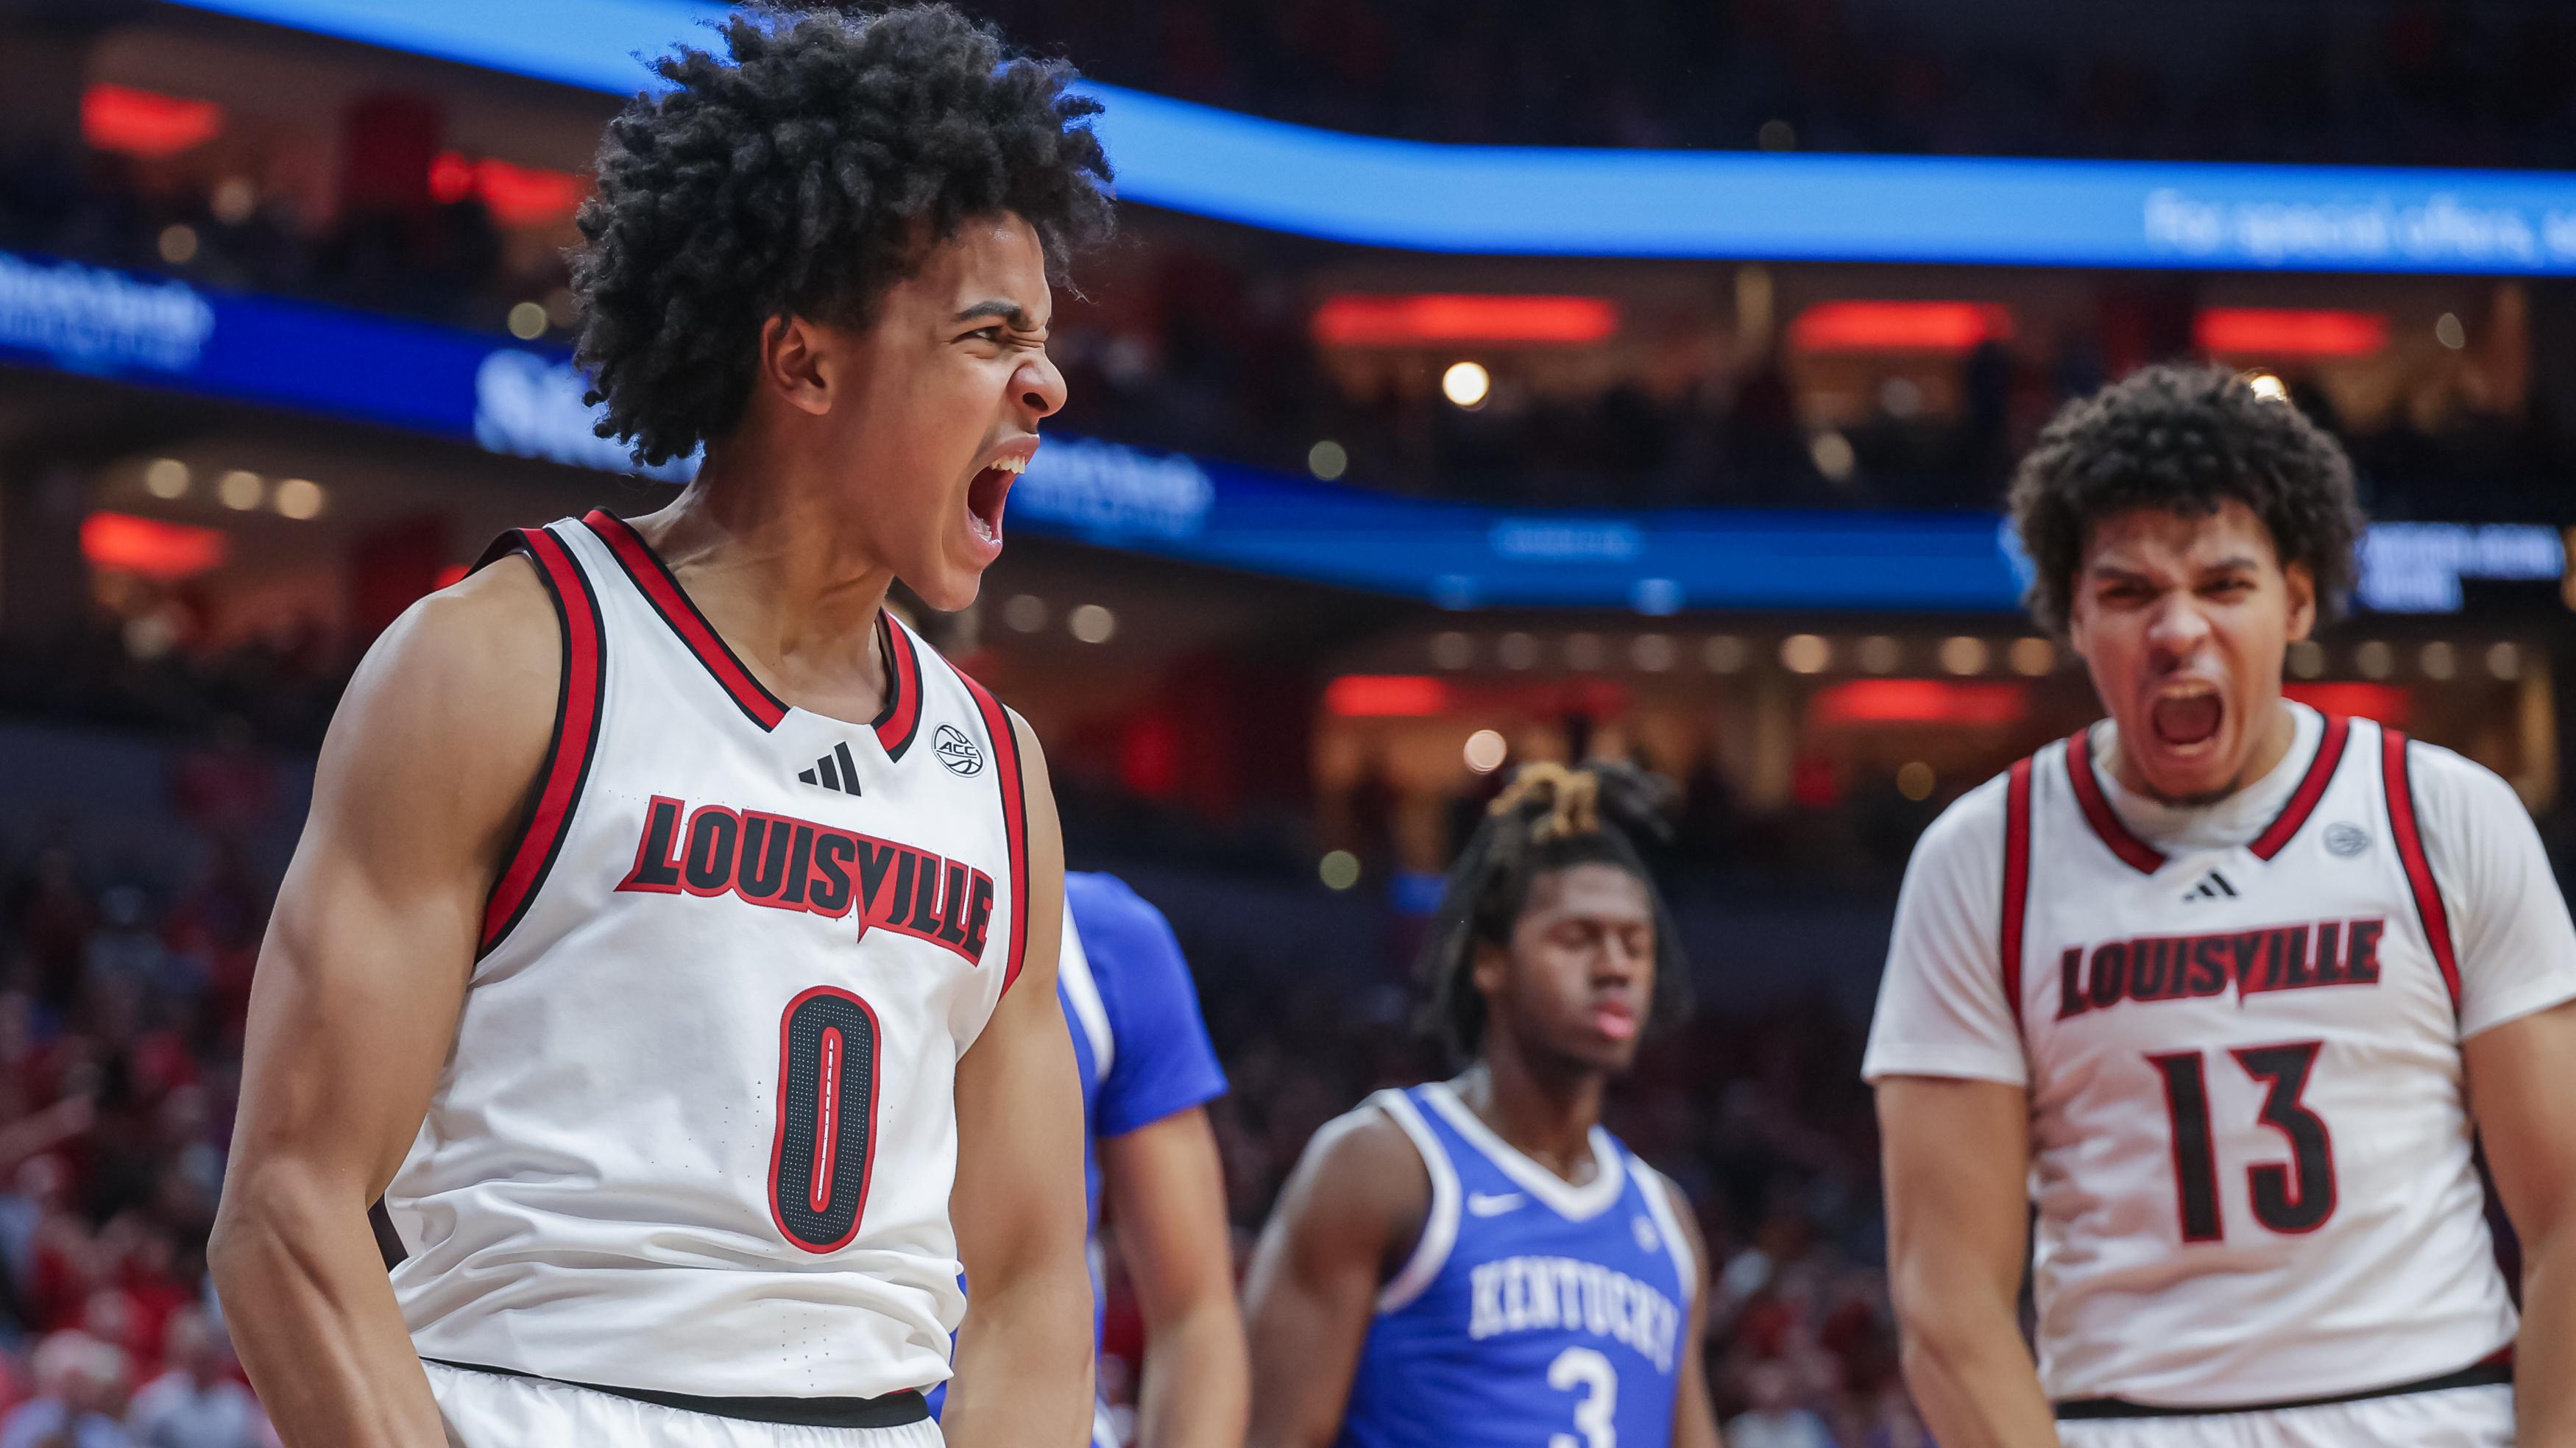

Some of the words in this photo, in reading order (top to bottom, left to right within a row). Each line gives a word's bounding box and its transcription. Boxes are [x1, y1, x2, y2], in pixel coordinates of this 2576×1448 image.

[938, 741, 976, 756] ACC
[613, 795, 994, 967] LOUISVILLE
[2055, 916, 2385, 1022] LOUISVILLE
[768, 985, 881, 1254] 0
[2142, 1040, 2338, 1242] 13
[1469, 1255, 1680, 1374] KENTUCKY
[1548, 1346, 1618, 1448] 3
